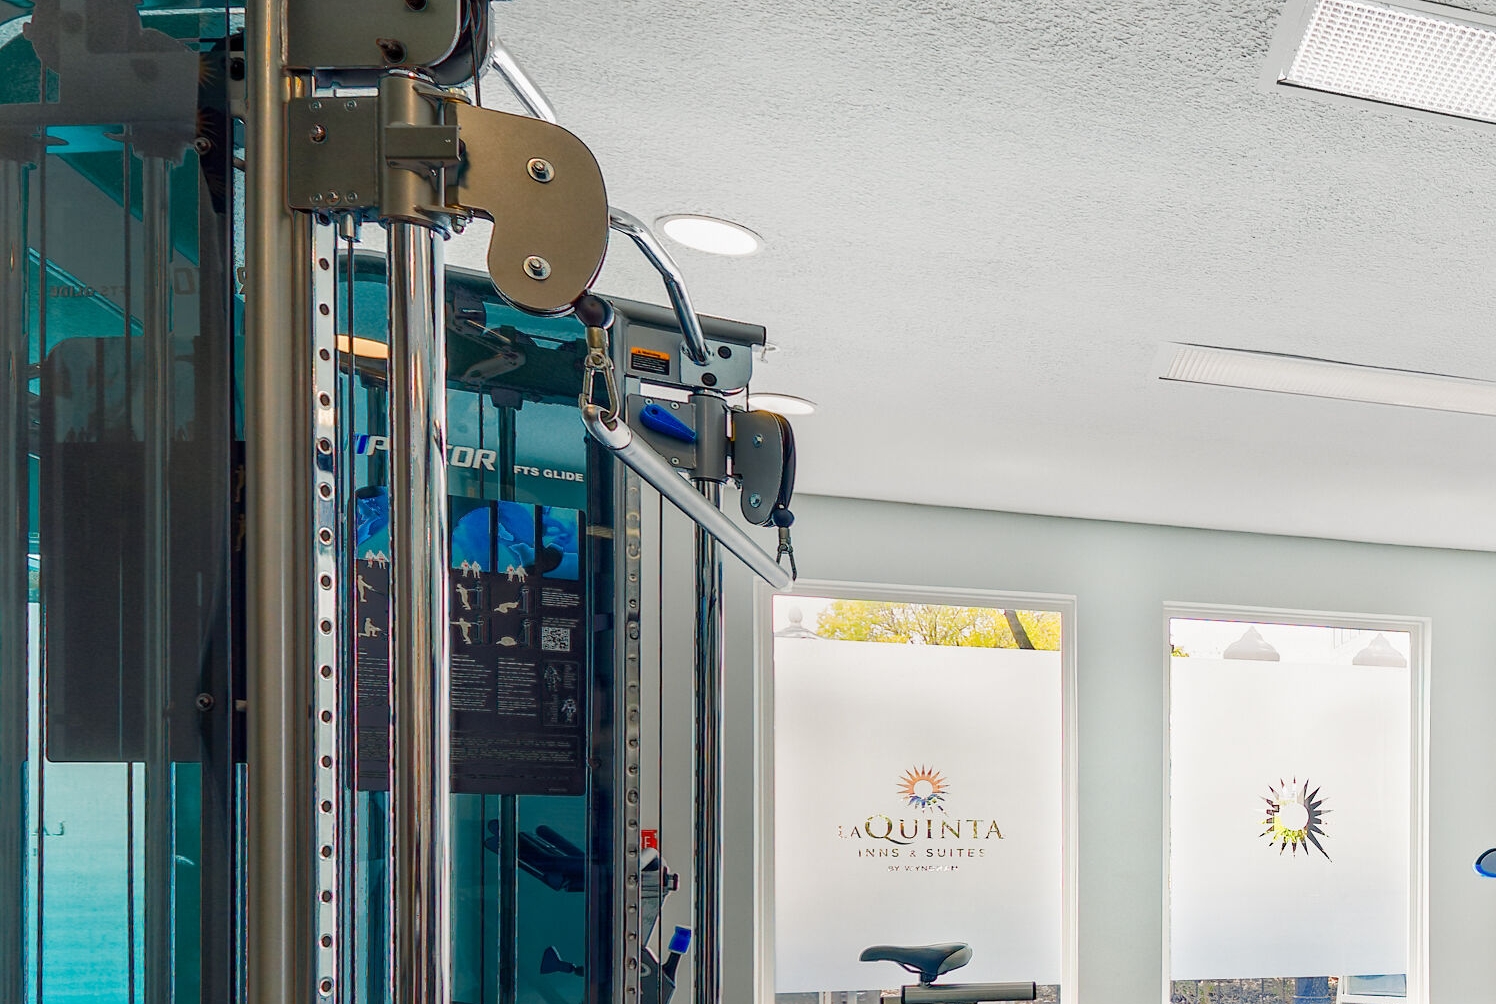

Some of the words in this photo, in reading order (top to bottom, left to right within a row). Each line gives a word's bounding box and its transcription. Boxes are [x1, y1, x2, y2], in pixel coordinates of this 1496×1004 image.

[513, 465, 540, 478] FTS
[542, 469, 584, 483] GLIDE
[858, 848, 899, 858] INNS
[926, 848, 986, 858] SUITES
